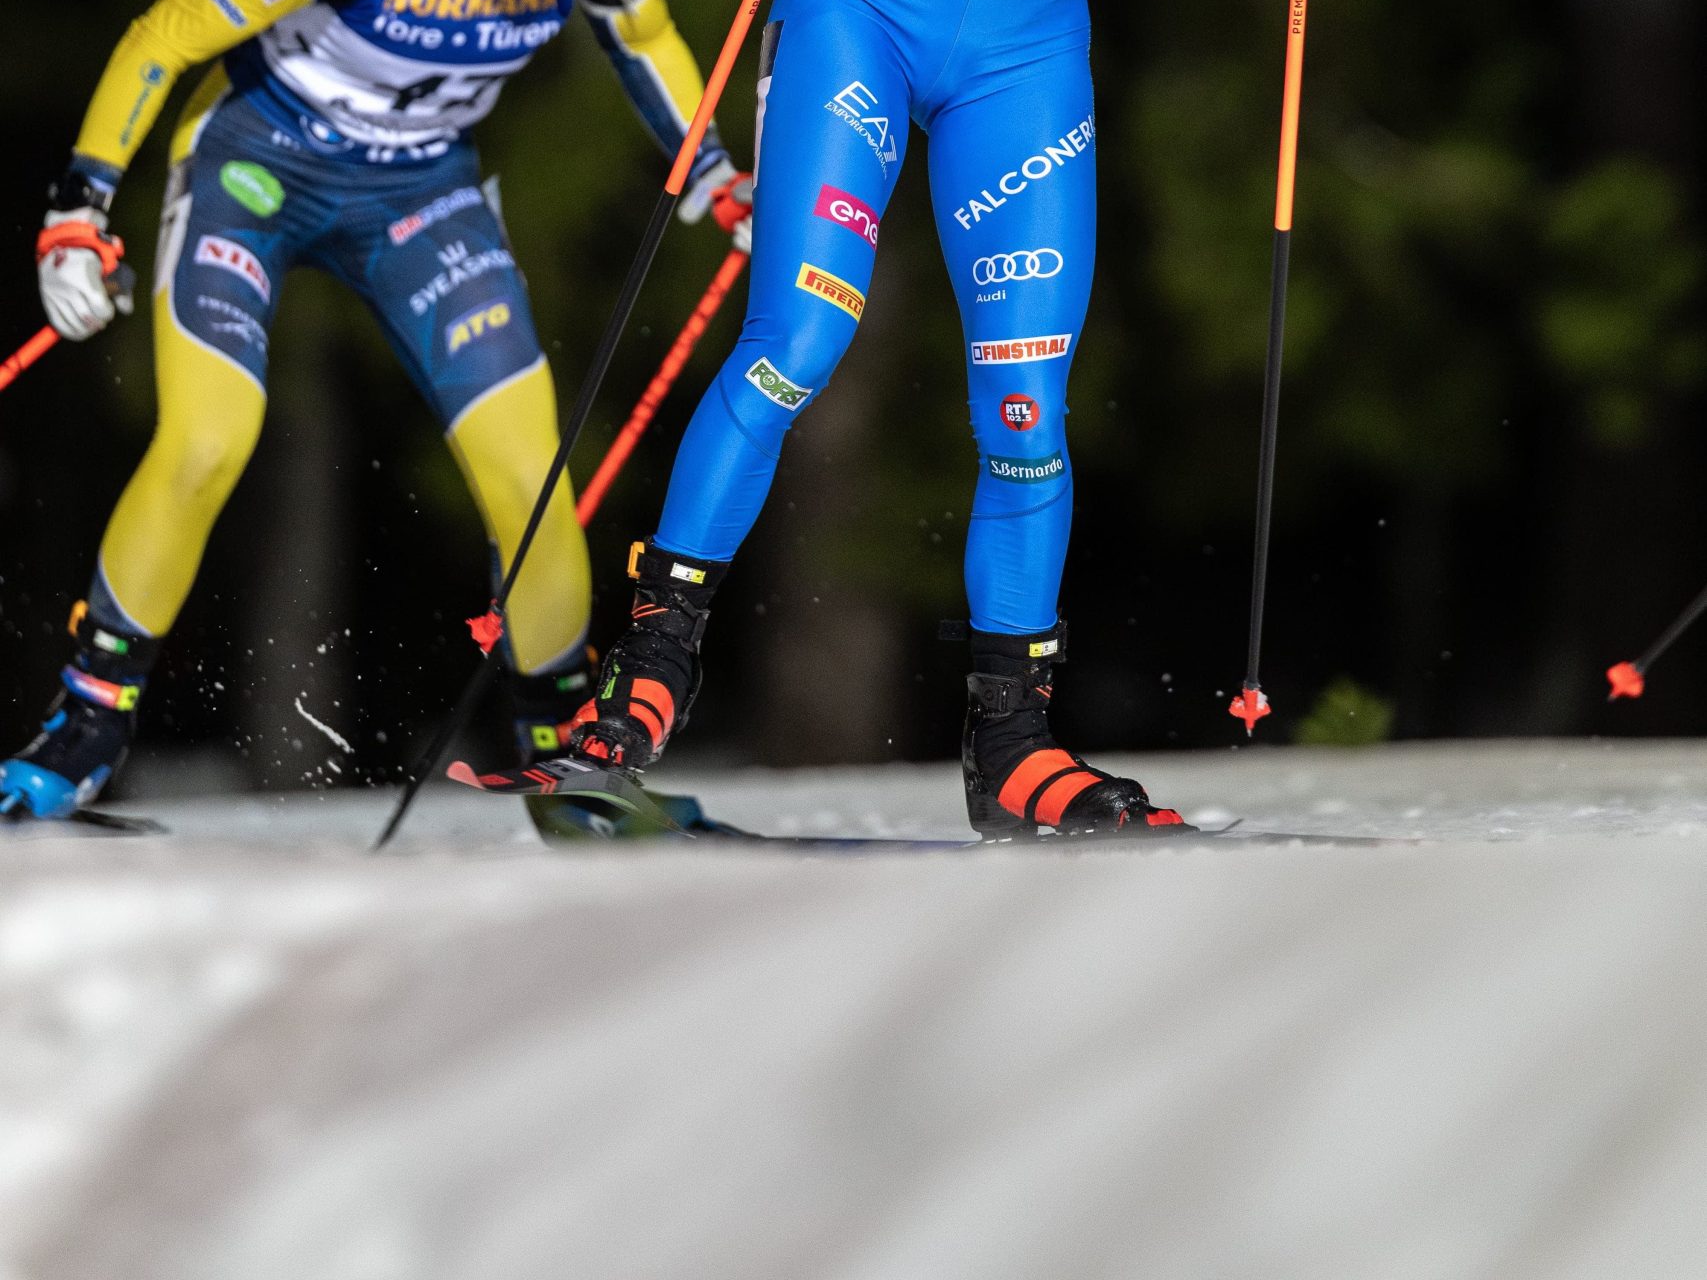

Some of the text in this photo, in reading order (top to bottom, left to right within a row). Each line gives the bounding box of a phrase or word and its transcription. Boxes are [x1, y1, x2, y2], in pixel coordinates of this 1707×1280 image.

[824, 100, 868, 137] EMPORIO
[976, 290, 1006, 303] Audi
[982, 338, 1066, 361] FINSTRAL
[1005, 403, 1031, 415] RTL
[1006, 414, 1032, 422] 102.5
